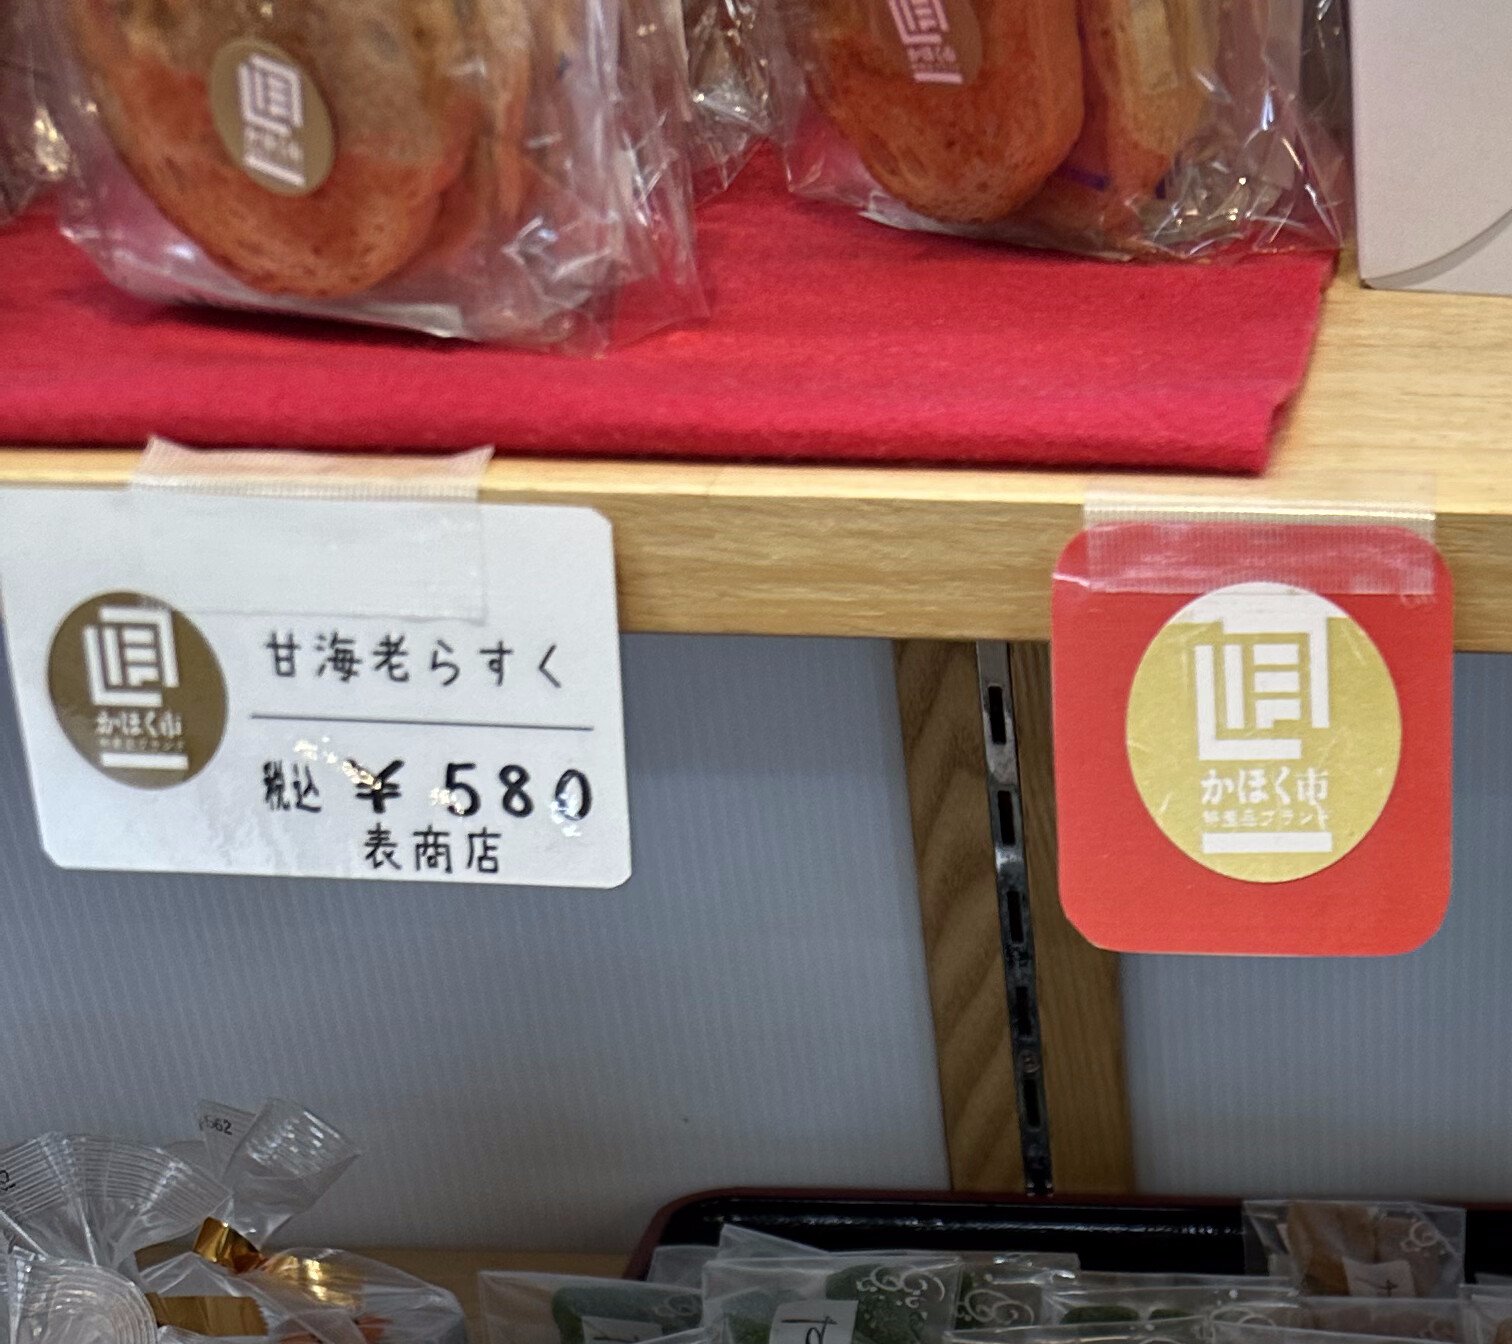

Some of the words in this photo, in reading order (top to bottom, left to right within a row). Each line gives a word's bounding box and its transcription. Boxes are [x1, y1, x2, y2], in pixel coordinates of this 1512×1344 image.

[265, 630, 562, 688] 甘海老らすく
[263, 760, 323, 813] 税込
[1201, 766, 1328, 805] かほく市
[363, 822, 503, 874] 表商店
